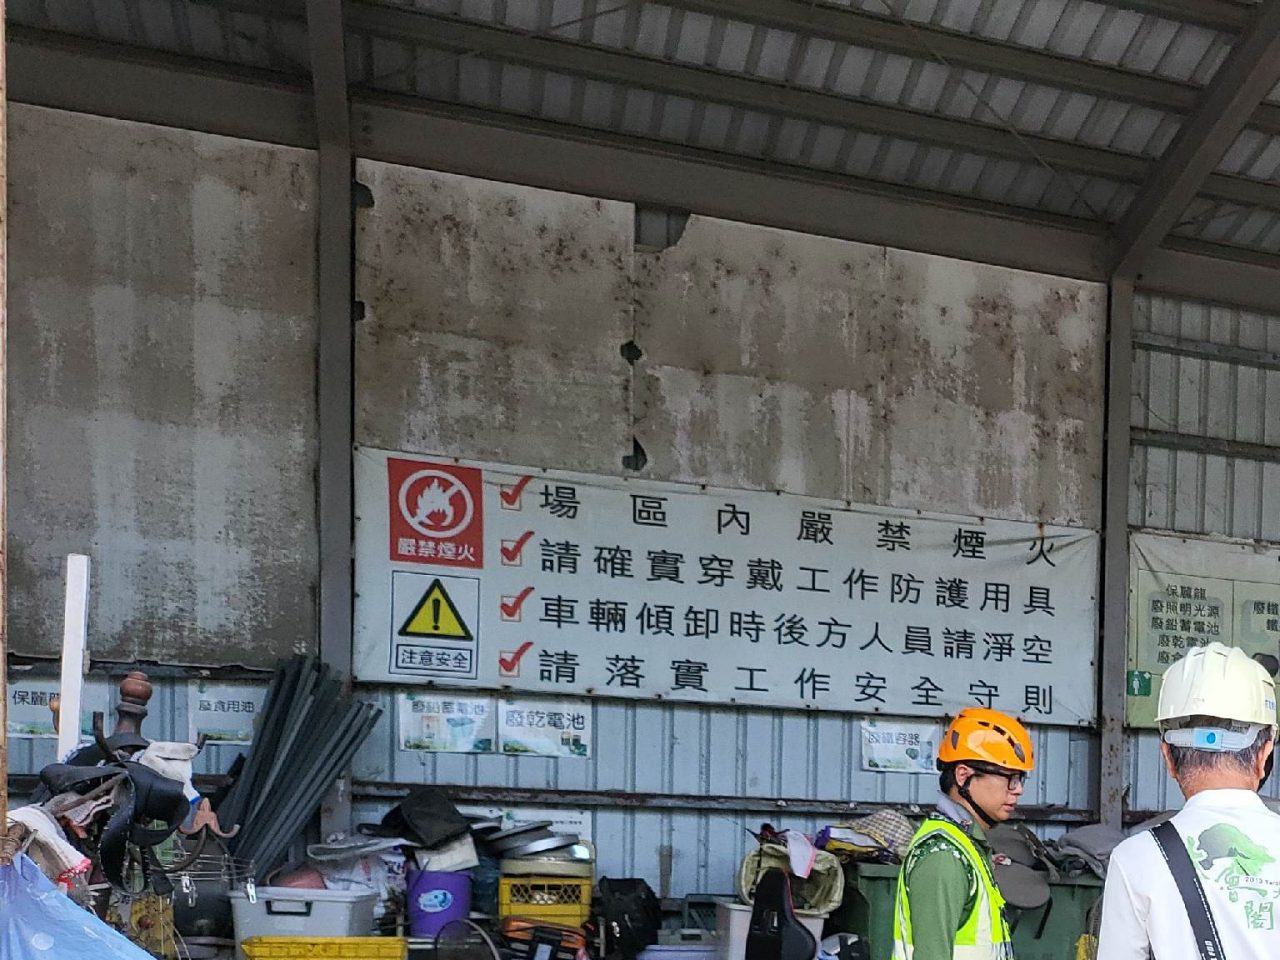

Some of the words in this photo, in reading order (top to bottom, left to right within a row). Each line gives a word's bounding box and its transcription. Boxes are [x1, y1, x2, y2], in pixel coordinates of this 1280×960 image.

[398, 538, 475, 561] 嚴禁煙火
[539, 485, 1056, 567] 場區內嚴禁煙火
[539, 538, 1055, 617] 請確實穿戴工作防護用具
[401, 650, 469, 669] 注意安全
[539, 595, 1053, 664] 車輛傾卸時後方人員請淨空
[539, 650, 1053, 715] 請落實工作安全守則
[505, 710, 585, 730] 廢乾電池
